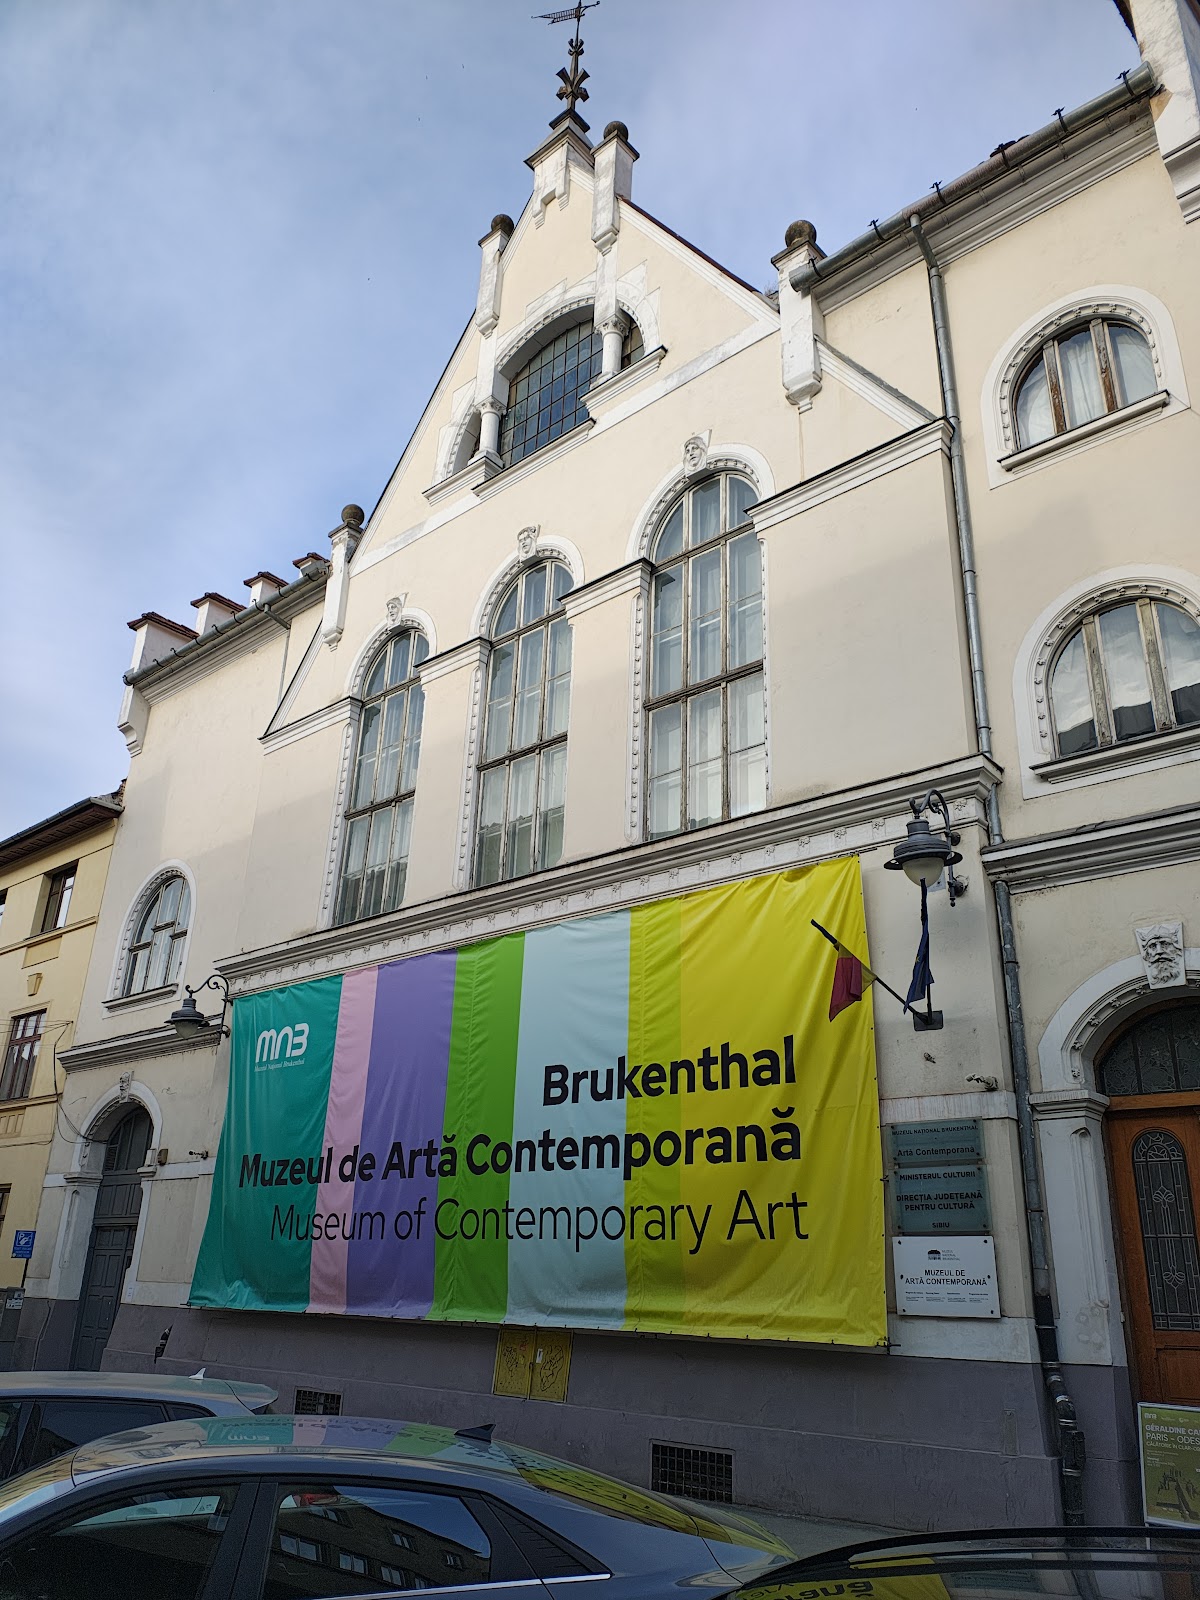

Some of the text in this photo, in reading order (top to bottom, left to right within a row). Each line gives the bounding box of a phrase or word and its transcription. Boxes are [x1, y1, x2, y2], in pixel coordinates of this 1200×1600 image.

[542, 1035, 797, 1107] Brukenthal
[238, 1106, 802, 1189] Muzeul de Artă Contemporană
[899, 1170, 976, 1181] MINISTERUL CULTURII
[904, 1201, 976, 1211] PENTRU CULTURĂ
[270, 1189, 809, 1256] Museum of Contemporary Art
[924, 1269, 966, 1277] MUZEUL DE
[904, 1277, 988, 1286] ARTĂ CONTEMPORANĂ
[1145, 1423, 1187, 1434] GÉRALDINE
[1145, 1432, 1169, 1441] PARIS
